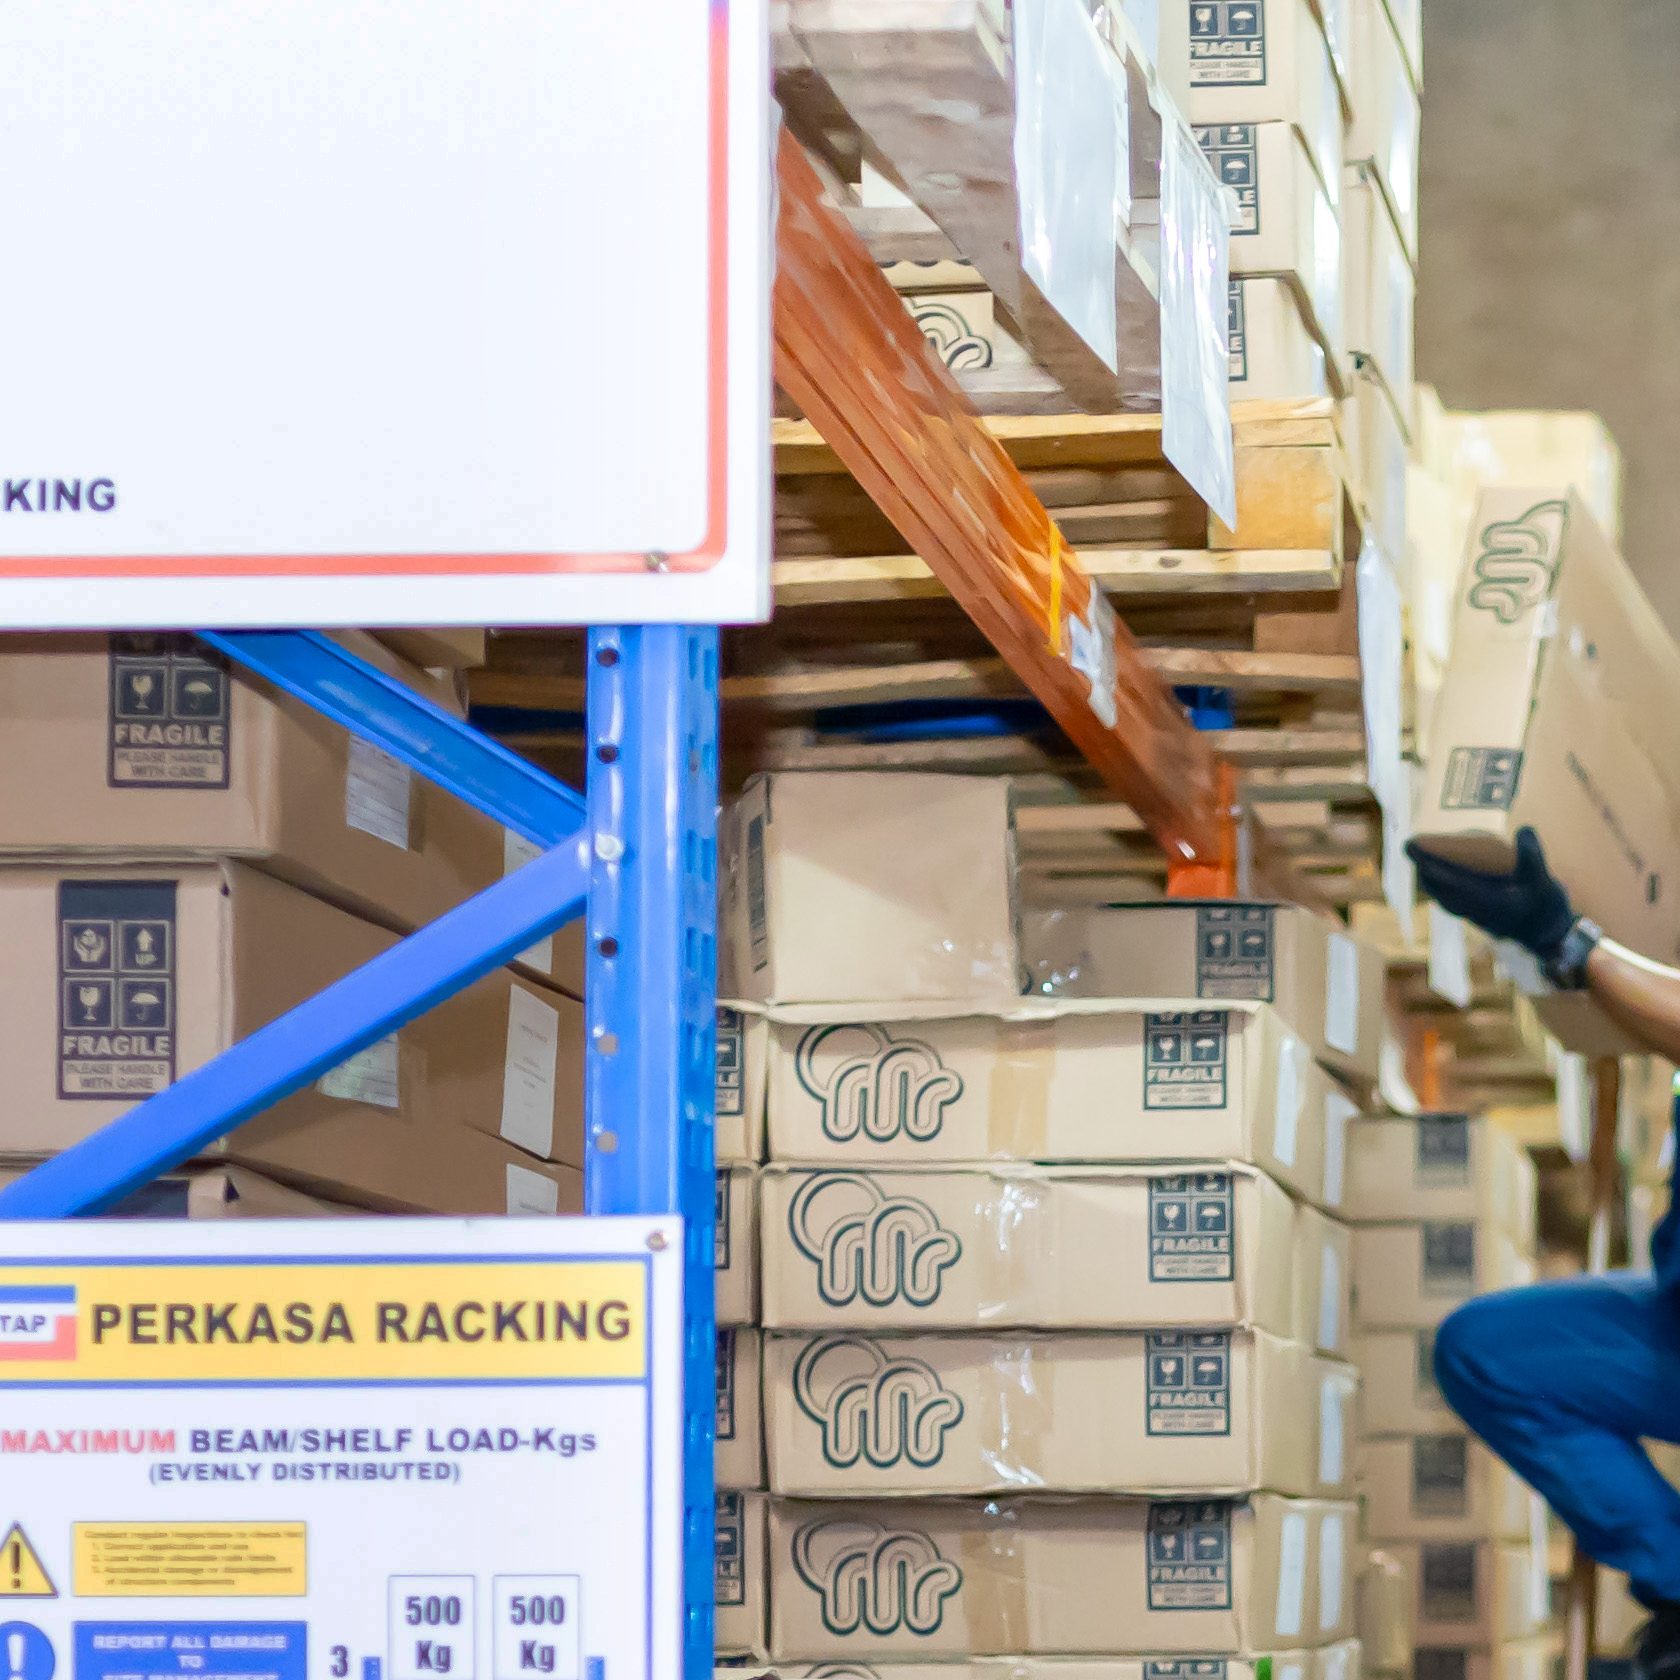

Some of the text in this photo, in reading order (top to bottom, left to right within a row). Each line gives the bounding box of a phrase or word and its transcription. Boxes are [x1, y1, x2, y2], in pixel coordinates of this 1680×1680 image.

[1188, 41, 1263, 57] FRAGILE
[114, 724, 225, 745] FRAGILE
[62, 1035, 170, 1056] FRAGILE
[1147, 1067, 1222, 1082] FRAGILE
[1152, 1237, 1228, 1253] FRAGILE
[92, 1302, 356, 1346] PERKASA
[376, 1299, 632, 1344] RACKING
[1149, 1391, 1225, 1408] FRAGILE
[1, 1427, 598, 1457] MAXIMUM BEAM/SHELF LOAD-Kgs
[149, 1461, 462, 1484] (EVENLY DISTRIBUTED)
[1151, 1567, 1227, 1582] FRAGILE
[405, 1596, 565, 1626] 500 500
[92, 1635, 287, 1650] REPORT ALL DAMAGE
[178, 1654, 205, 1669] TO
[330, 1645, 349, 1678] 3
[416, 1640, 555, 1673] Kg Kg
